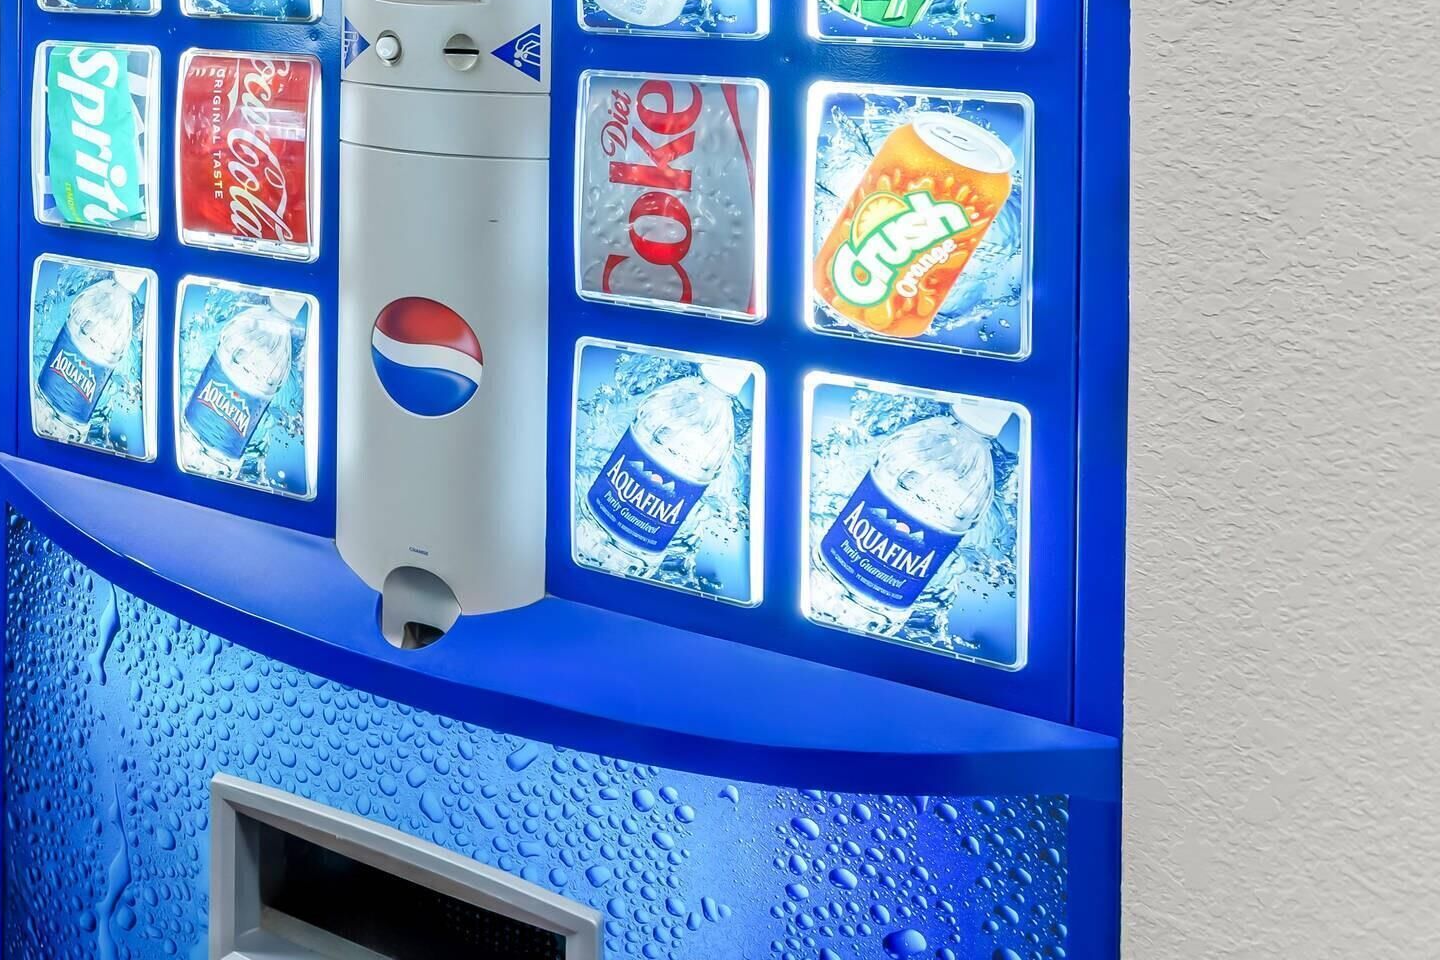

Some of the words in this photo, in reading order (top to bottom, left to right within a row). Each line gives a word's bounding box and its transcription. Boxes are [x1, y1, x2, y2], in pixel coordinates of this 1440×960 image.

[212, 67, 227, 145] ORIGINAL
[601, 90, 631, 157] Diet
[213, 150, 224, 199] TASTE
[833, 190, 971, 306] Crush
[896, 239, 957, 297] Orange
[49, 349, 96, 402] AQUAFINA
[198, 379, 250, 437] AQUAFINA
[604, 490, 622, 512] Purity
[620, 507, 661, 535] Guaranteed
[606, 454, 685, 525] AQUAFINA
[841, 539, 862, 563] Purity
[860, 558, 907, 588] Guaranteed
[843, 500, 936, 578] AQUAFINA
